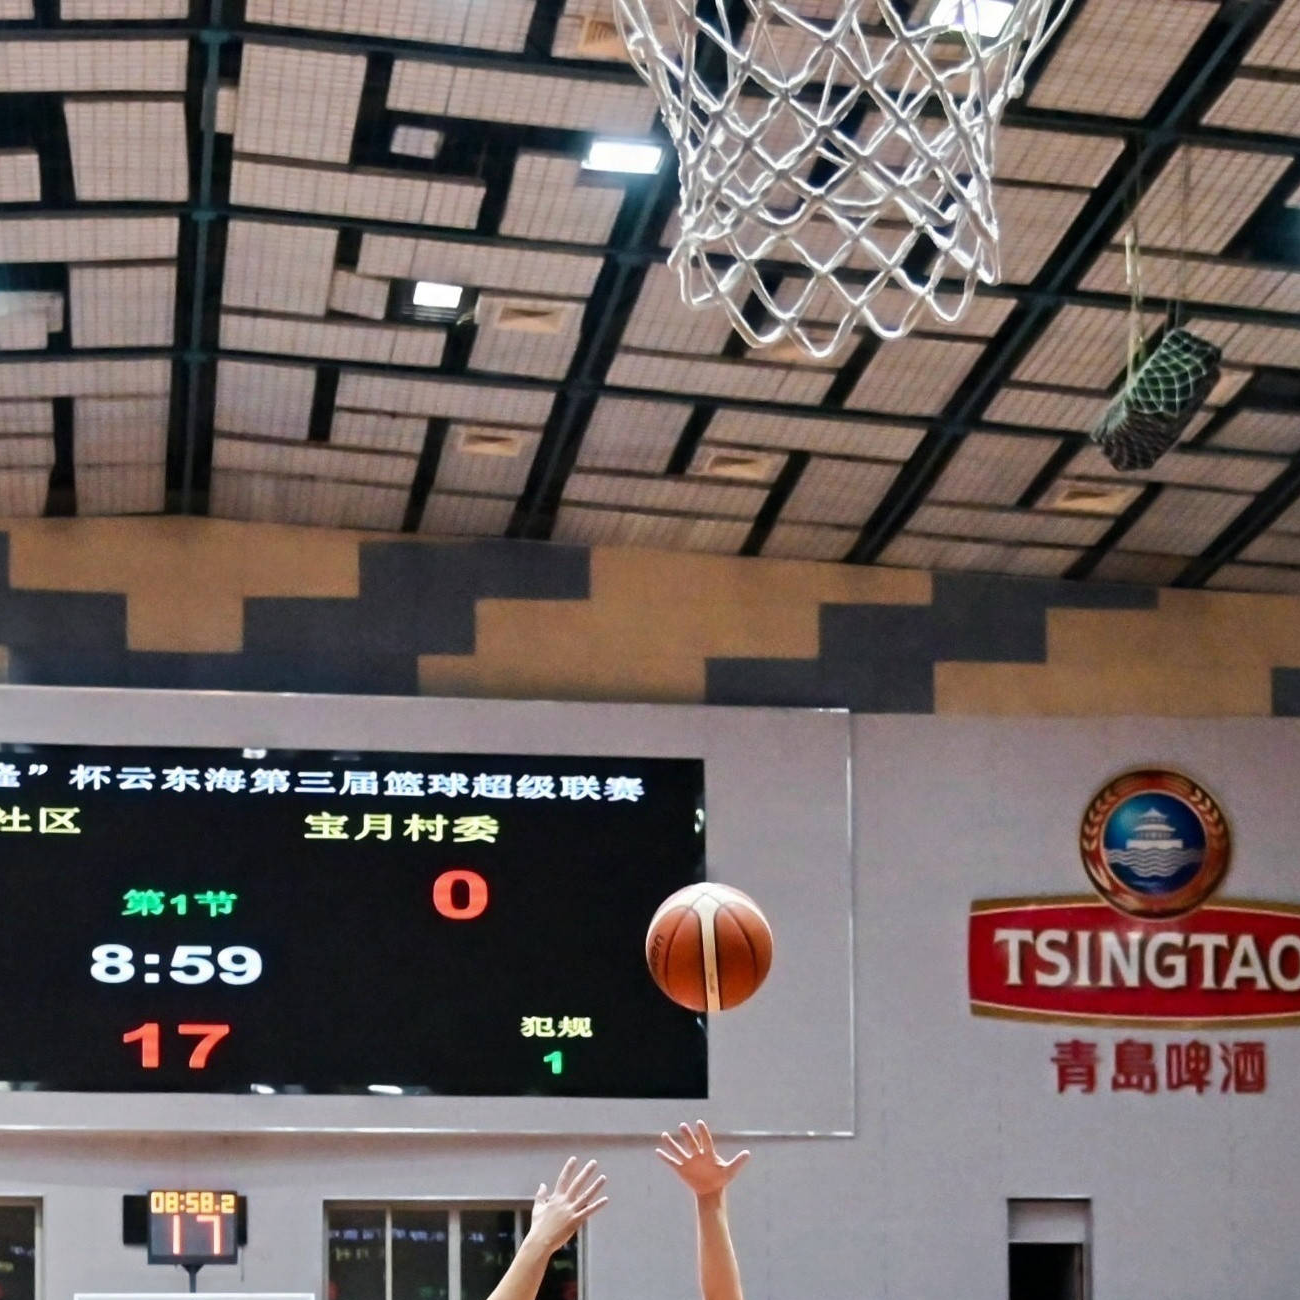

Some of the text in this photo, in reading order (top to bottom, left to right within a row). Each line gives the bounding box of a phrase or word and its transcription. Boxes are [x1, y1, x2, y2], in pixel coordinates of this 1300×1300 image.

[303, 811, 499, 843] 宝月村委
[121, 888, 238, 917] 第1节
[432, 870, 488, 920] 0
[90, 943, 263, 985] 8:59
[520, 1016, 593, 1038] 犯规
[123, 1022, 230, 1068] 17
[543, 1050, 563, 1074] 1
[151, 1191, 235, 1213] 08:58.2
[172, 1214, 221, 1255] 17
